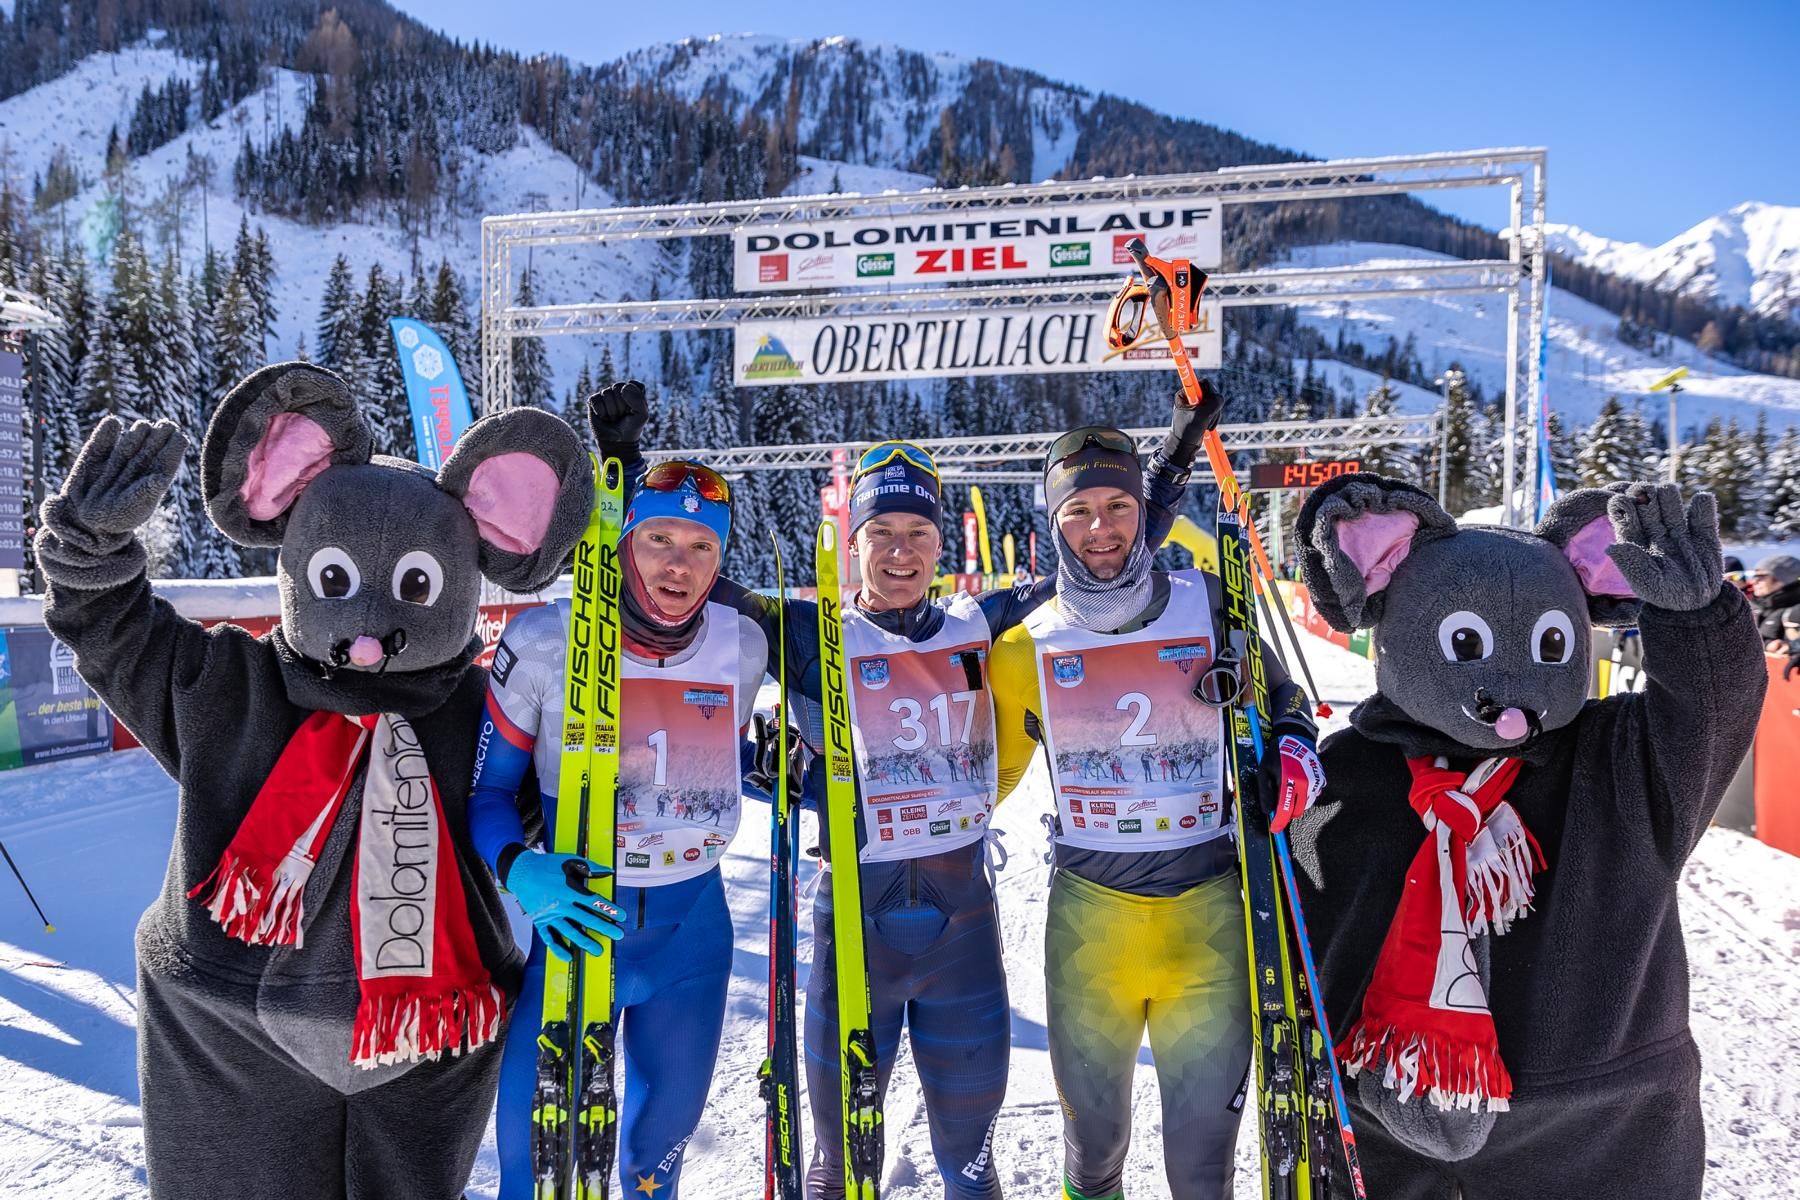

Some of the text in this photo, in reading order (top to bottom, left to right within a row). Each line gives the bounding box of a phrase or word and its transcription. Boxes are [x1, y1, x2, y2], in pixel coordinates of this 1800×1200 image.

[747, 208, 1212, 252] DOLOMITENLAUF
[914, 245, 1027, 274] ZIEL
[812, 313, 1096, 376] OBERTILLIACH
[741, 359, 804, 373] OBERTILLIACH
[856, 484, 910, 507] Fiamme
[915, 484, 936, 504] Oro
[570, 540, 595, 717] FISCHER
[597, 543, 618, 720] FISCHER
[1239, 548, 1272, 723] FISCHER
[822, 596, 849, 755] FISCHER
[38, 702, 55, 715] der
[57, 699, 82, 713] beste
[84, 697, 101, 711] Weg
[567, 722, 585, 730] ITALIA
[595, 724, 615, 732] ITALIA
[888, 690, 977, 751] 317
[1116, 692, 1158, 746] 2
[647, 729, 667, 786] 1
[832, 755, 849, 763] ITALIA
[871, 794, 910, 803] DOLOMITENLAUF
[901, 806, 926, 814] KLEINE
[902, 812, 927, 820] ZEITUNG
[626, 854, 649, 865] Gösser
[593, 900, 619, 917] KV+
[1265, 968, 1276, 985] 3D
[781, 1083, 793, 1167] FISCHER
